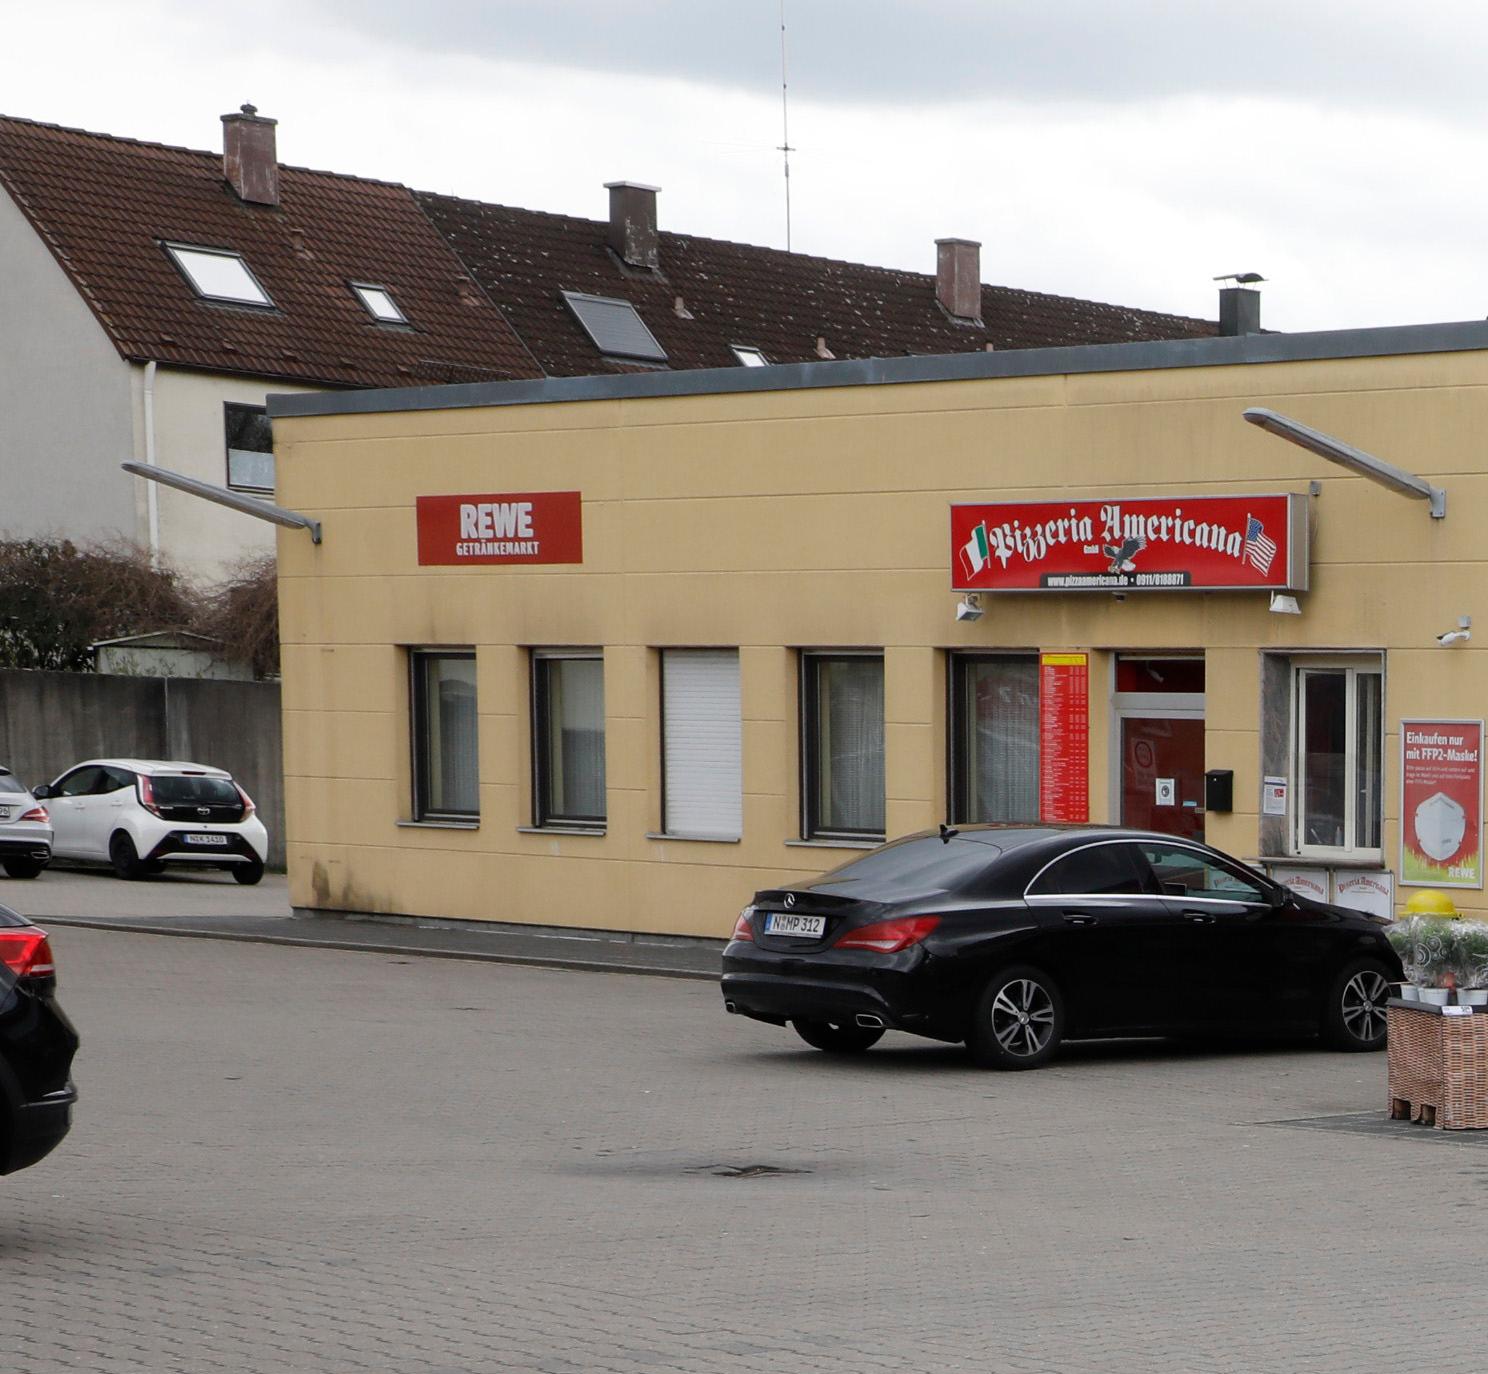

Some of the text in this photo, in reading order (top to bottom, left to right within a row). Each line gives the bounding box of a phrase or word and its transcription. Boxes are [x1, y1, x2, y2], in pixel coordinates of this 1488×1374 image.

[460, 502, 534, 540] REWE
[989, 504, 1243, 570] Pizzeria Americana
[456, 539, 539, 556] GETRÄNKEMARKT
[1406, 731, 1464, 746] Einkaufen nur
[1406, 748, 1478, 762] mit FFP2-Maske!
[1448, 866, 1476, 880] REWE
[786, 917, 800, 931] MP
[800, 917, 820, 933] 312
